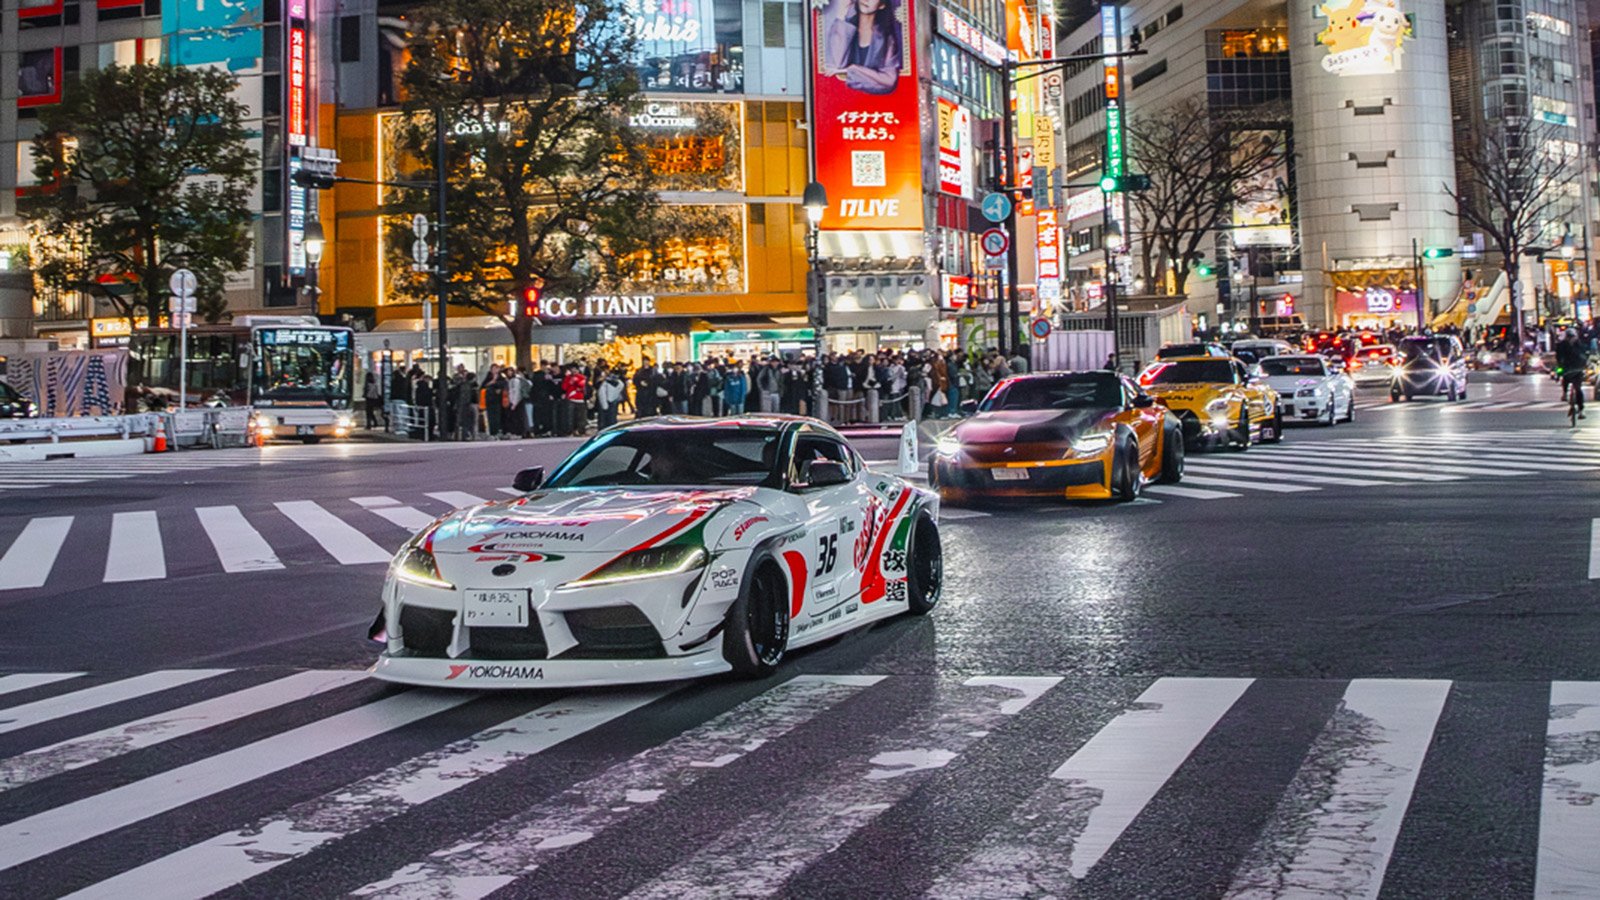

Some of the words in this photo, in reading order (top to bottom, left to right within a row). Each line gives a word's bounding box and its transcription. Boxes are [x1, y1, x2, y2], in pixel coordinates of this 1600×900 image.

[840, 199, 900, 217] 17LIVE
[504, 531, 585, 542] YOKOHAMA
[814, 533, 838, 577] 36
[711, 568, 736, 581] POP
[714, 577, 739, 589] RACE
[469, 665, 544, 680] YOKOHAMA
